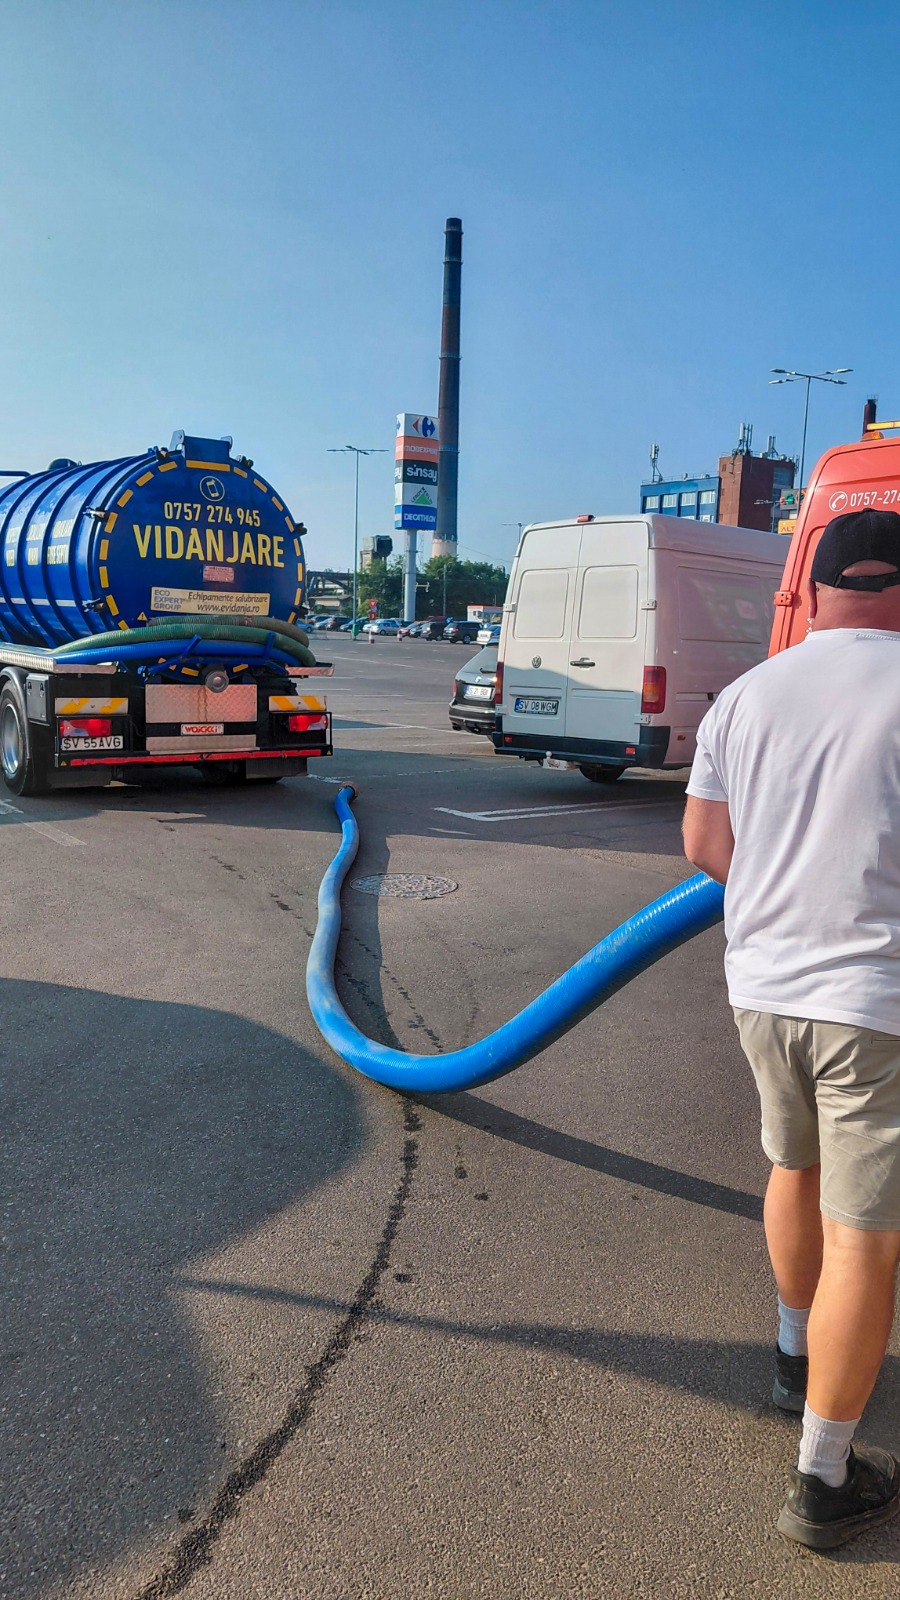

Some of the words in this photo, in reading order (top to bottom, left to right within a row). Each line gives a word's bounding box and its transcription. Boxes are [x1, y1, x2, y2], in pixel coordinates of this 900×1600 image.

[406, 464, 438, 483] sinsay
[164, 501, 201, 521] 0757
[206, 504, 233, 524] 274
[236, 507, 261, 527] 945
[132, 524, 285, 568] VIDANJARE
[154, 589, 171, 597] ECO
[188, 591, 234, 602] Echipamente
[154, 596, 183, 605] EXPERT
[154, 602, 182, 611] GROUP
[197, 602, 260, 614] www.evidanja.ro
[520, 700, 529, 710] SV
[541, 701, 557, 712] WGM
[63, 737, 79, 749] SV
[83, 737, 97, 749] 55
[99, 737, 121, 748] AVG
